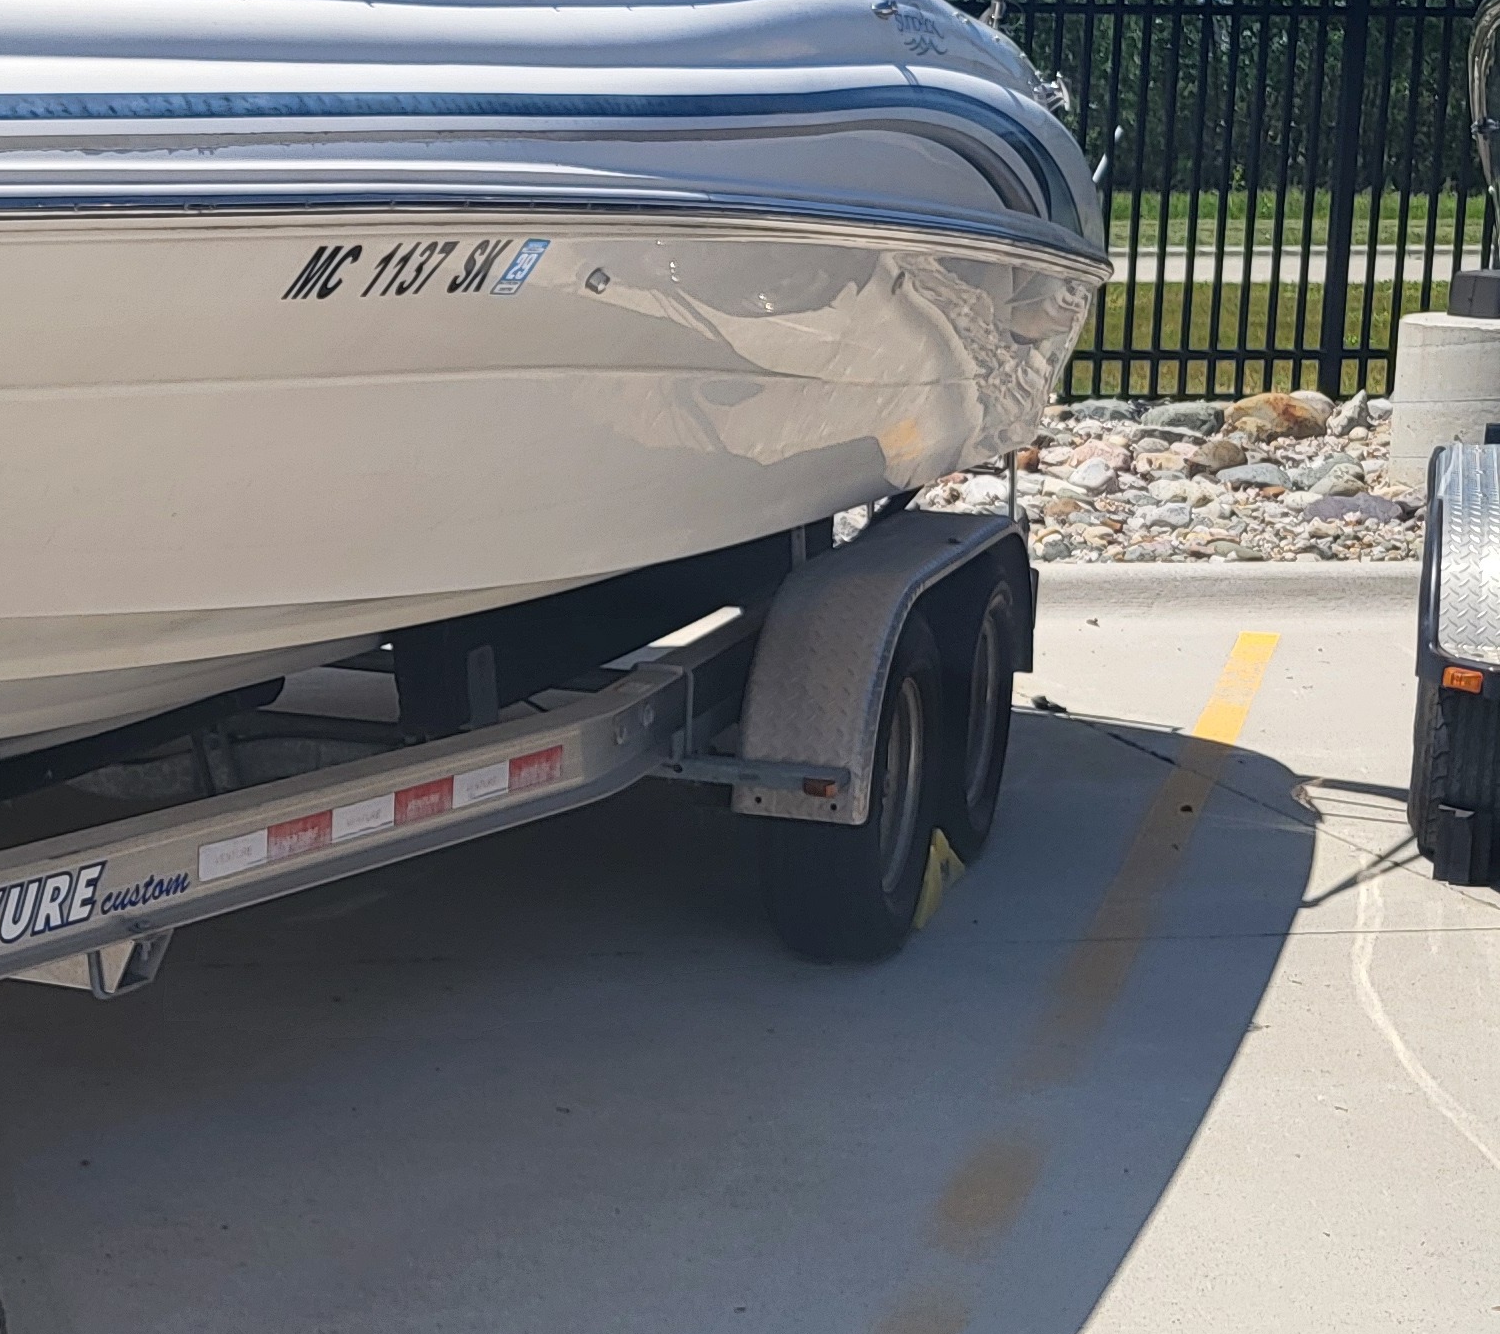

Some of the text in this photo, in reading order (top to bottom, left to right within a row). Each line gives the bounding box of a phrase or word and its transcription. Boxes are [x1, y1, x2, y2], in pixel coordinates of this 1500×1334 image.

[281, 239, 514, 300] MC 1137 SK
[505, 253, 539, 280] 29
[101, 872, 191, 915] custom
